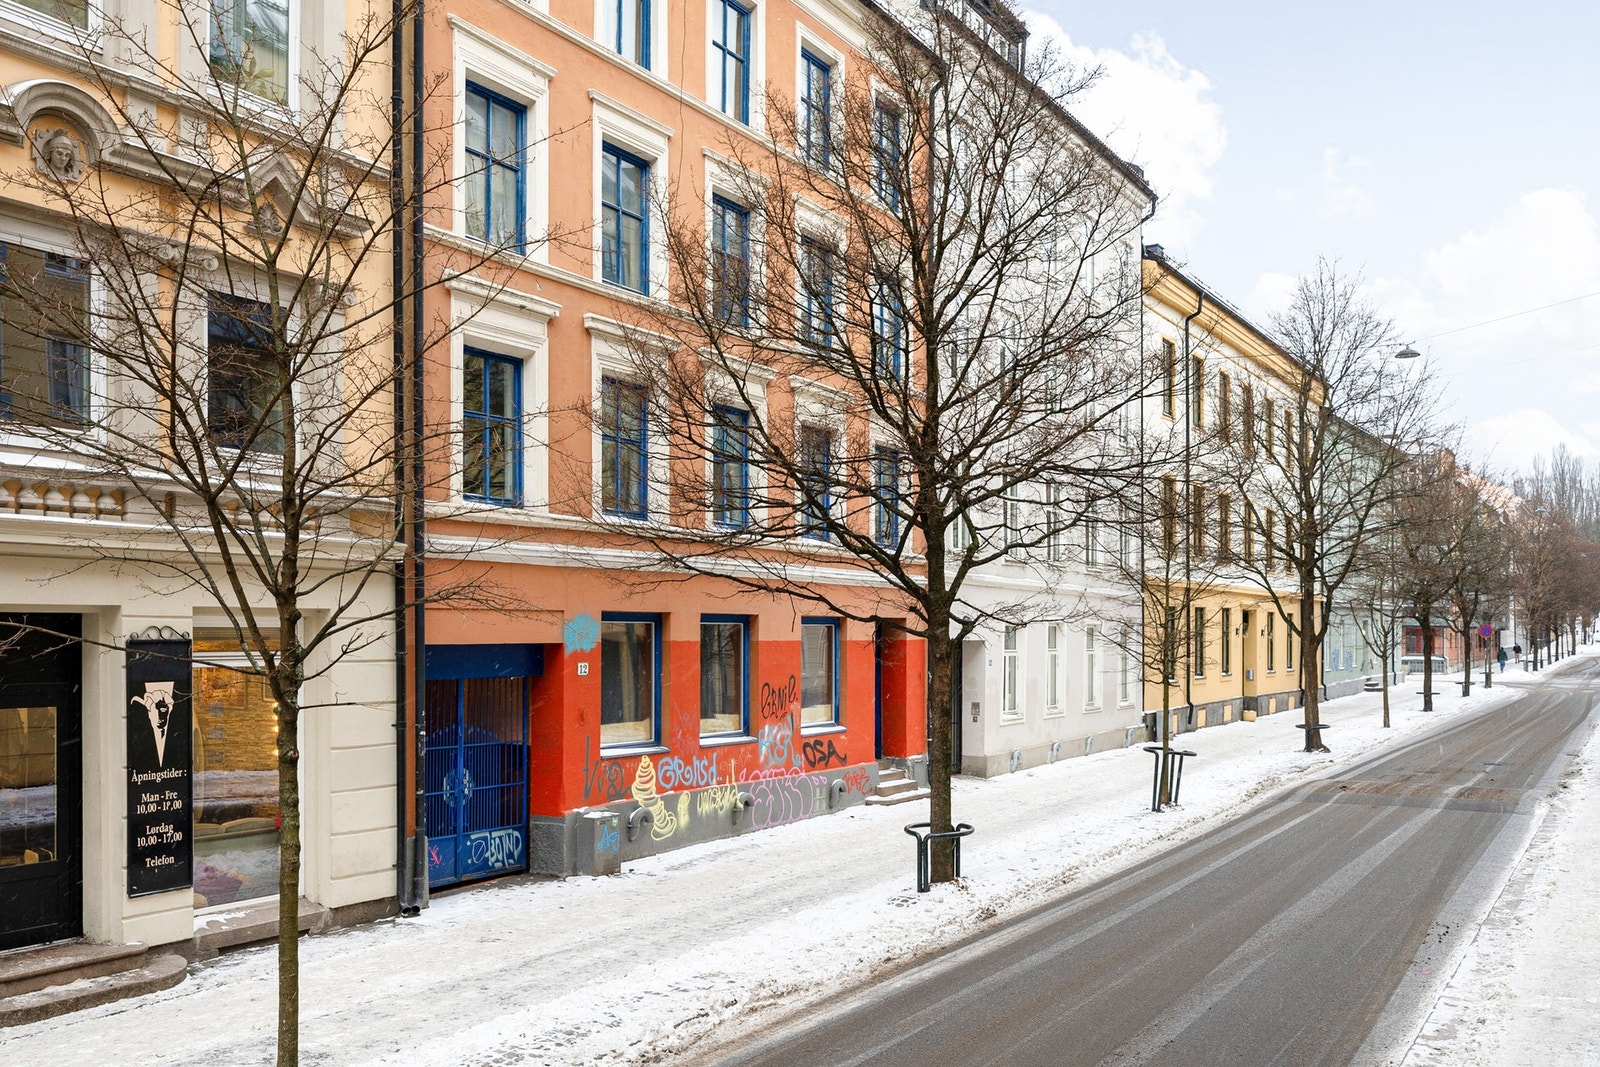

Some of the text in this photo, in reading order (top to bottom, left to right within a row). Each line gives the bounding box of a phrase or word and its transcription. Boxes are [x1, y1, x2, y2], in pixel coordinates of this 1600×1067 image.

[579, 664, 588, 675] 12
[141, 793, 160, 803] Man
[165, 790, 178, 800] Fre
[145, 854, 175, 868] Telefon
